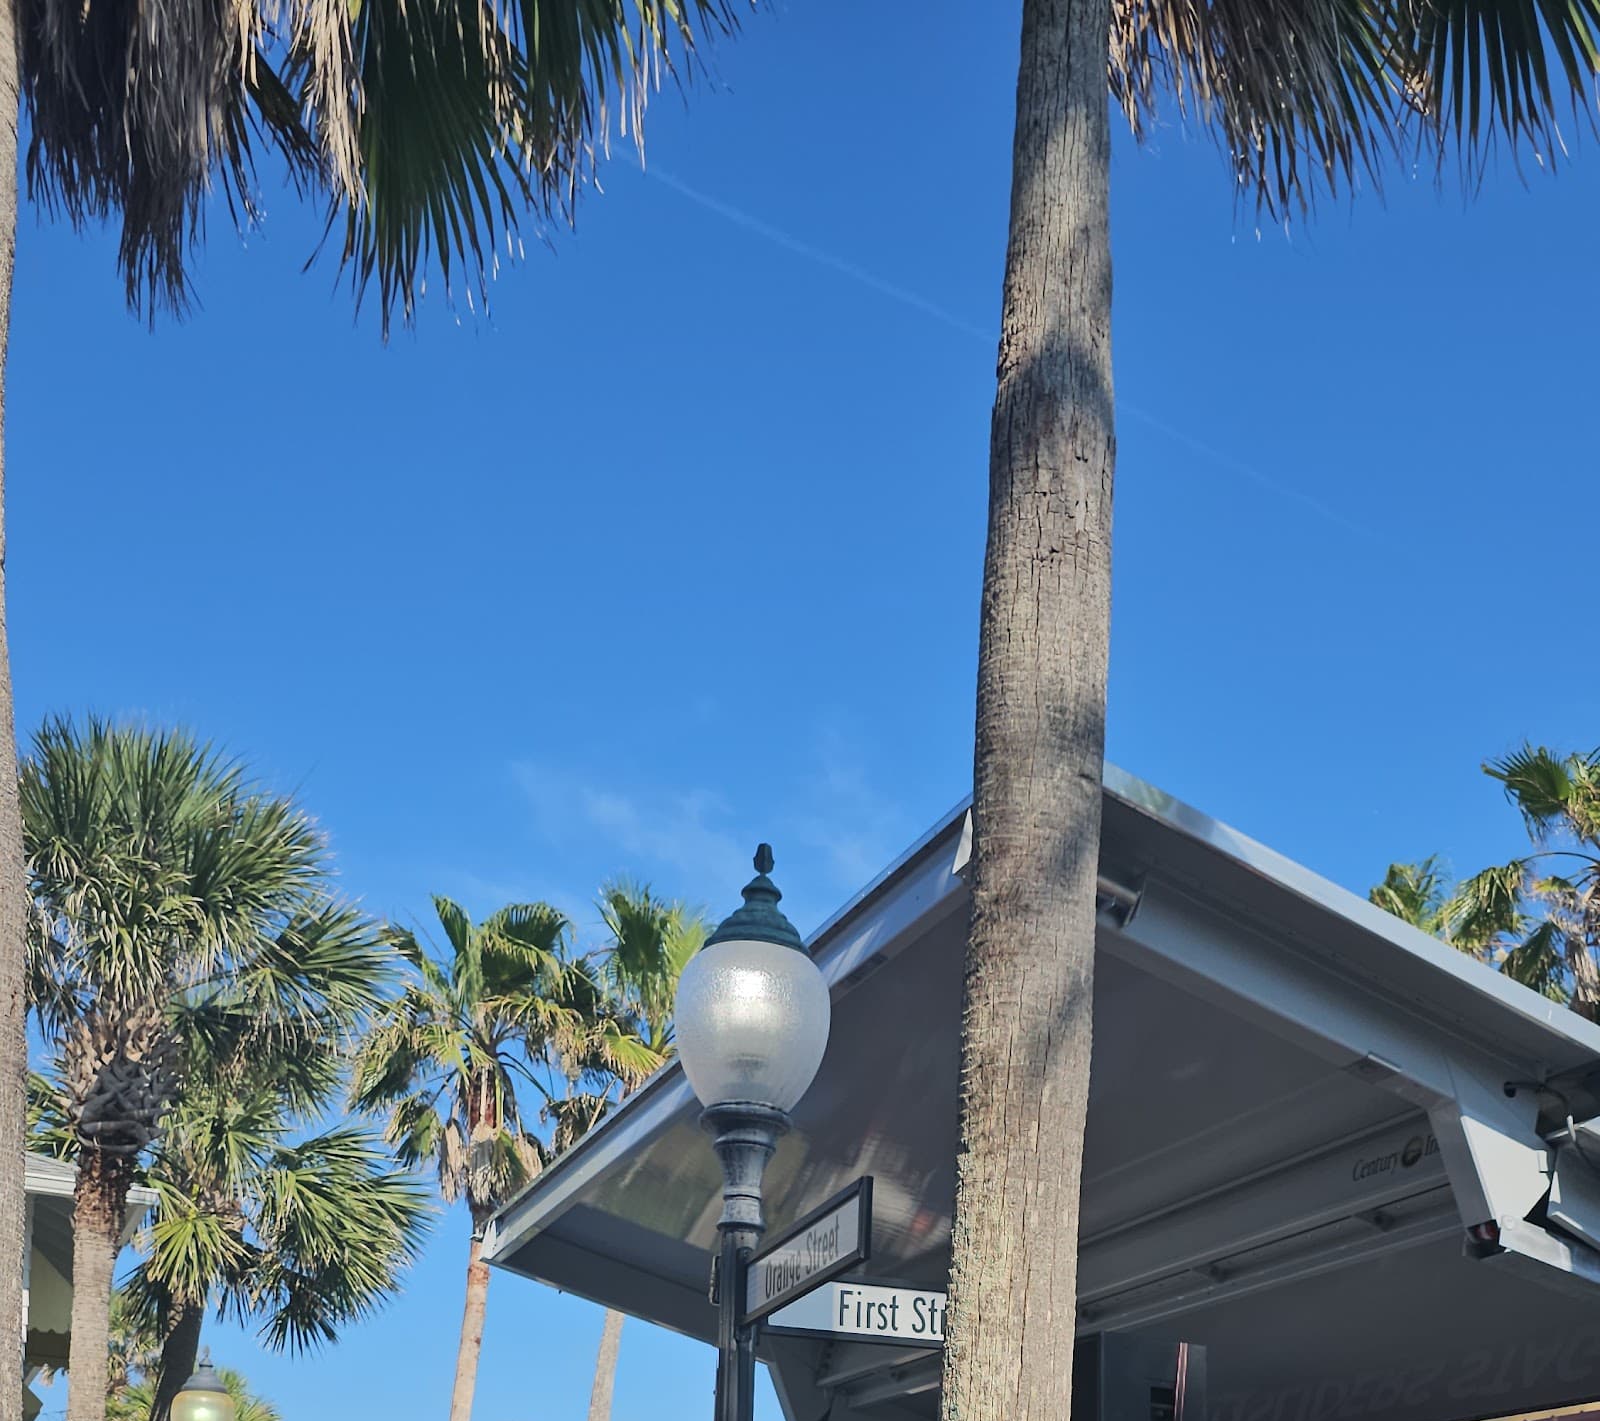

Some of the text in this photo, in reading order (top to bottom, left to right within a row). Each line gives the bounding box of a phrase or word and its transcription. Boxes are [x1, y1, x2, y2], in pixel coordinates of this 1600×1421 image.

[1352, 1152, 1400, 1182] Century
[765, 1215, 840, 1299] Orange Street
[839, 1289, 899, 1331] First
